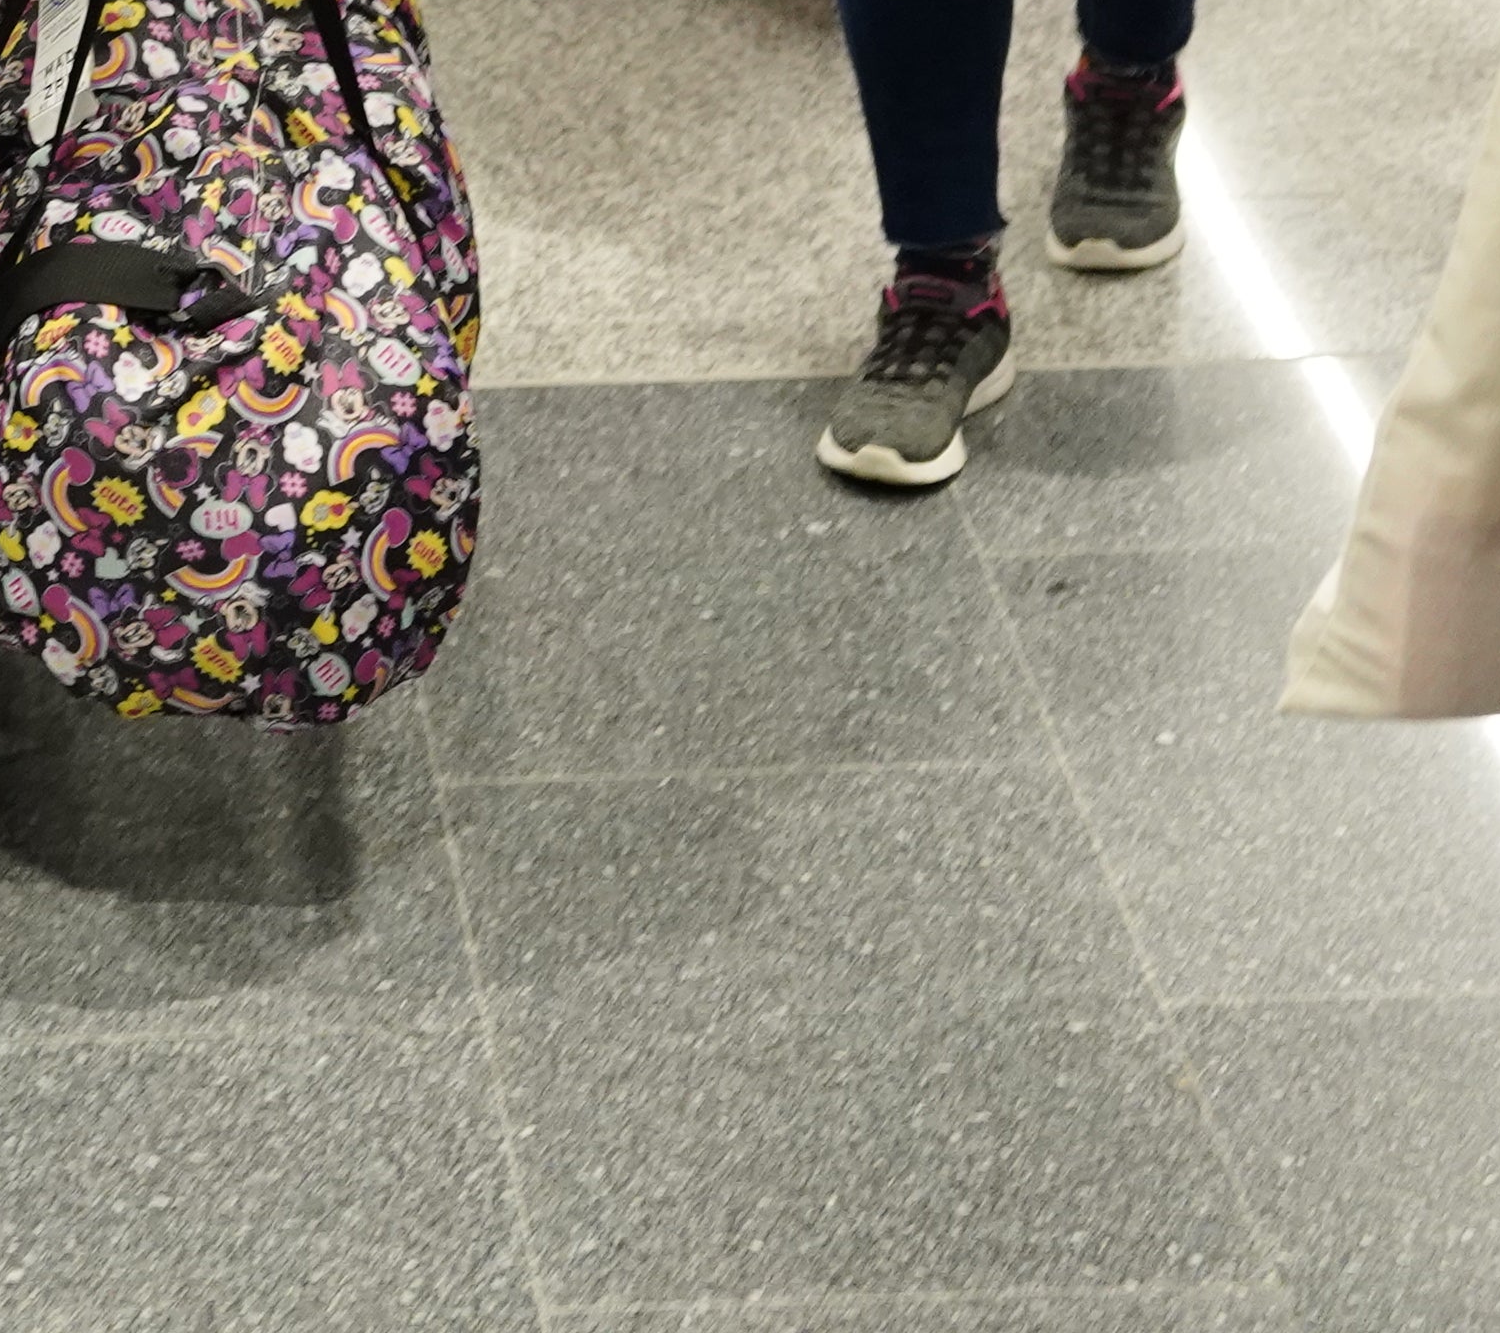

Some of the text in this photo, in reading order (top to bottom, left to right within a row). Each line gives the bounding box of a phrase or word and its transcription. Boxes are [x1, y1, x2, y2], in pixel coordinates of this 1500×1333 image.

[377, 343, 413, 378] hi!
[99, 484, 139, 517] cute
[202, 509, 240, 531] hi!
[414, 540, 442, 568] cute
[8, 576, 34, 610] hi!
[314, 658, 345, 691] hi!
